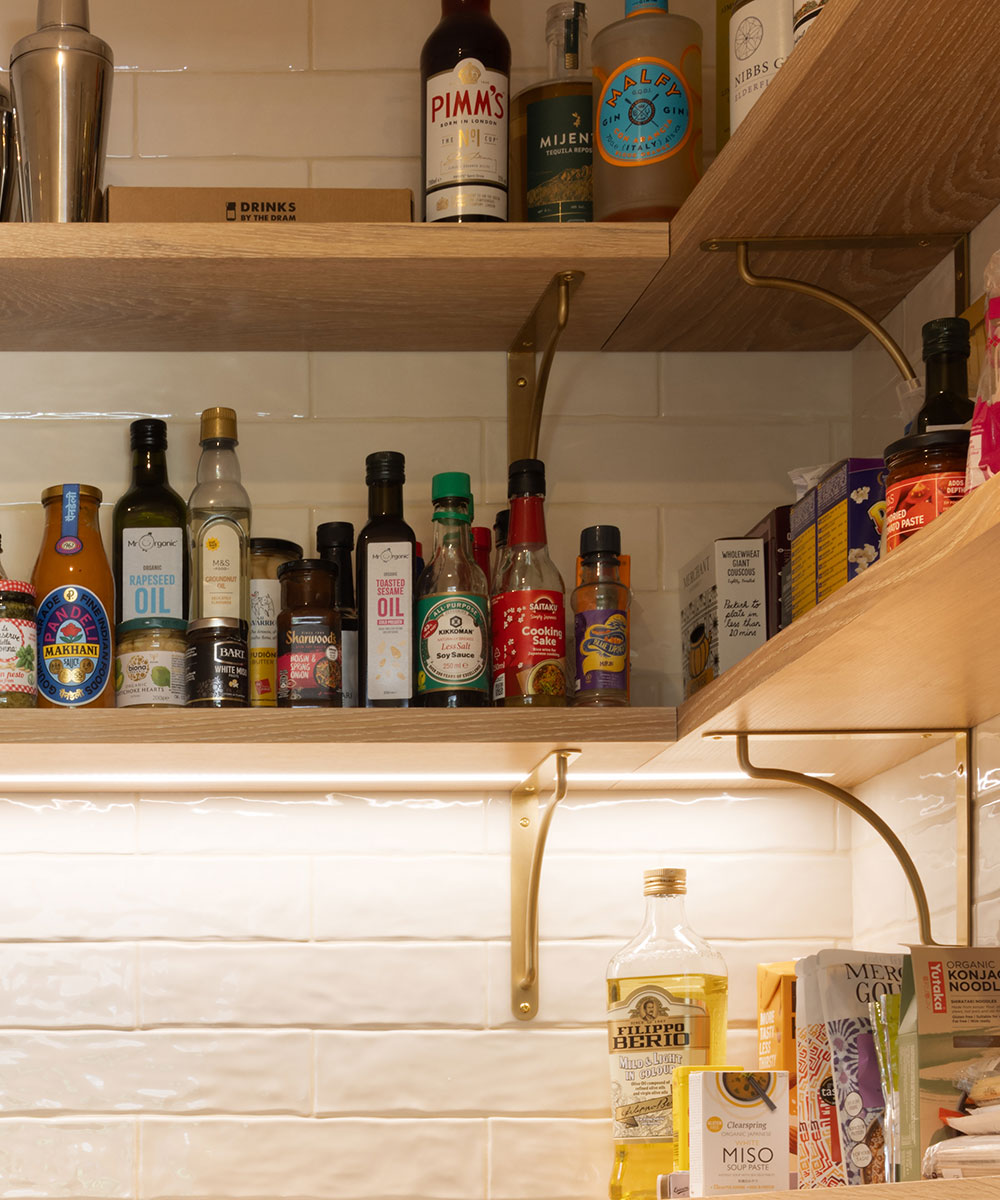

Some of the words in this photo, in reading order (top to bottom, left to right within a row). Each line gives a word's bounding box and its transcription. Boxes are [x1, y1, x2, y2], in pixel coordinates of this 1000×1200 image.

[606, 69, 681, 108] MALFY
[432, 85, 505, 123] PIMM'S
[663, 106, 684, 115] GIN
[440, 120, 457, 128] BORN
[602, 114, 620, 127] GIN
[540, 131, 593, 149] MIJEN
[546, 147, 573, 156] TEQUILA
[240, 201, 296, 212] DRINKS
[240, 214, 251, 222] BY
[253, 214, 269, 222] THE
[270, 214, 296, 222] DRAM
[900, 514, 924, 528] PASTE
[721, 549, 760, 559] WHOLEWHEAT
[212, 559, 230, 567] M&S
[732, 559, 750, 568] GIANT
[727, 568, 756, 577] COUSCOUS
[129, 574, 175, 586] RAPESEED
[205, 575, 238, 583] GROUNDNUT
[376, 579, 405, 587] TOASTED
[377, 587, 404, 596] SESAME
[80, 593, 100, 617] FINE
[134, 587, 171, 614] OIL
[751, 598, 762, 610] to
[377, 597, 405, 617] OIL
[529, 603, 557, 611] SAITAKU
[36, 594, 61, 636] GRADE
[724, 608, 746, 620] plate
[43, 607, 98, 643] PANDELI
[724, 618, 740, 629] less
[97, 617, 111, 655] INDIAN
[285, 630, 337, 646] Sharwood's
[521, 625, 563, 640] Cooking
[728, 628, 739, 637] 10
[441, 642, 457, 651] Less
[457, 641, 471, 650] Salt
[532, 636, 557, 646] Sake
[44, 644, 98, 657] MAKHANI
[436, 652, 450, 660] Soy
[63, 658, 79, 667] SAUCE
[290, 654, 310, 663] HOISIN
[311, 654, 317, 663] &
[214, 665, 237, 673] WHITE
[290, 663, 311, 671] SPRING
[87, 655, 111, 696] FOODS
[290, 672, 309, 680] ONION
[946, 960, 996, 969] ORGANIC
[929, 963, 945, 1011] Yutaka
[759, 1010, 775, 1026] MORE
[617, 1022, 685, 1036] FILIPPO
[613, 1032, 690, 1050] BERIO
[759, 1041, 771, 1056] LESS
[619, 1055, 643, 1070] MILD
[644, 1057, 652, 1067] &
[653, 1052, 683, 1065] LIGHT
[625, 1071, 635, 1081] IN
[726, 1120, 767, 1131] Clearspring
[722, 1146, 774, 1164] MISO
[747, 1163, 769, 1171] PASTE
